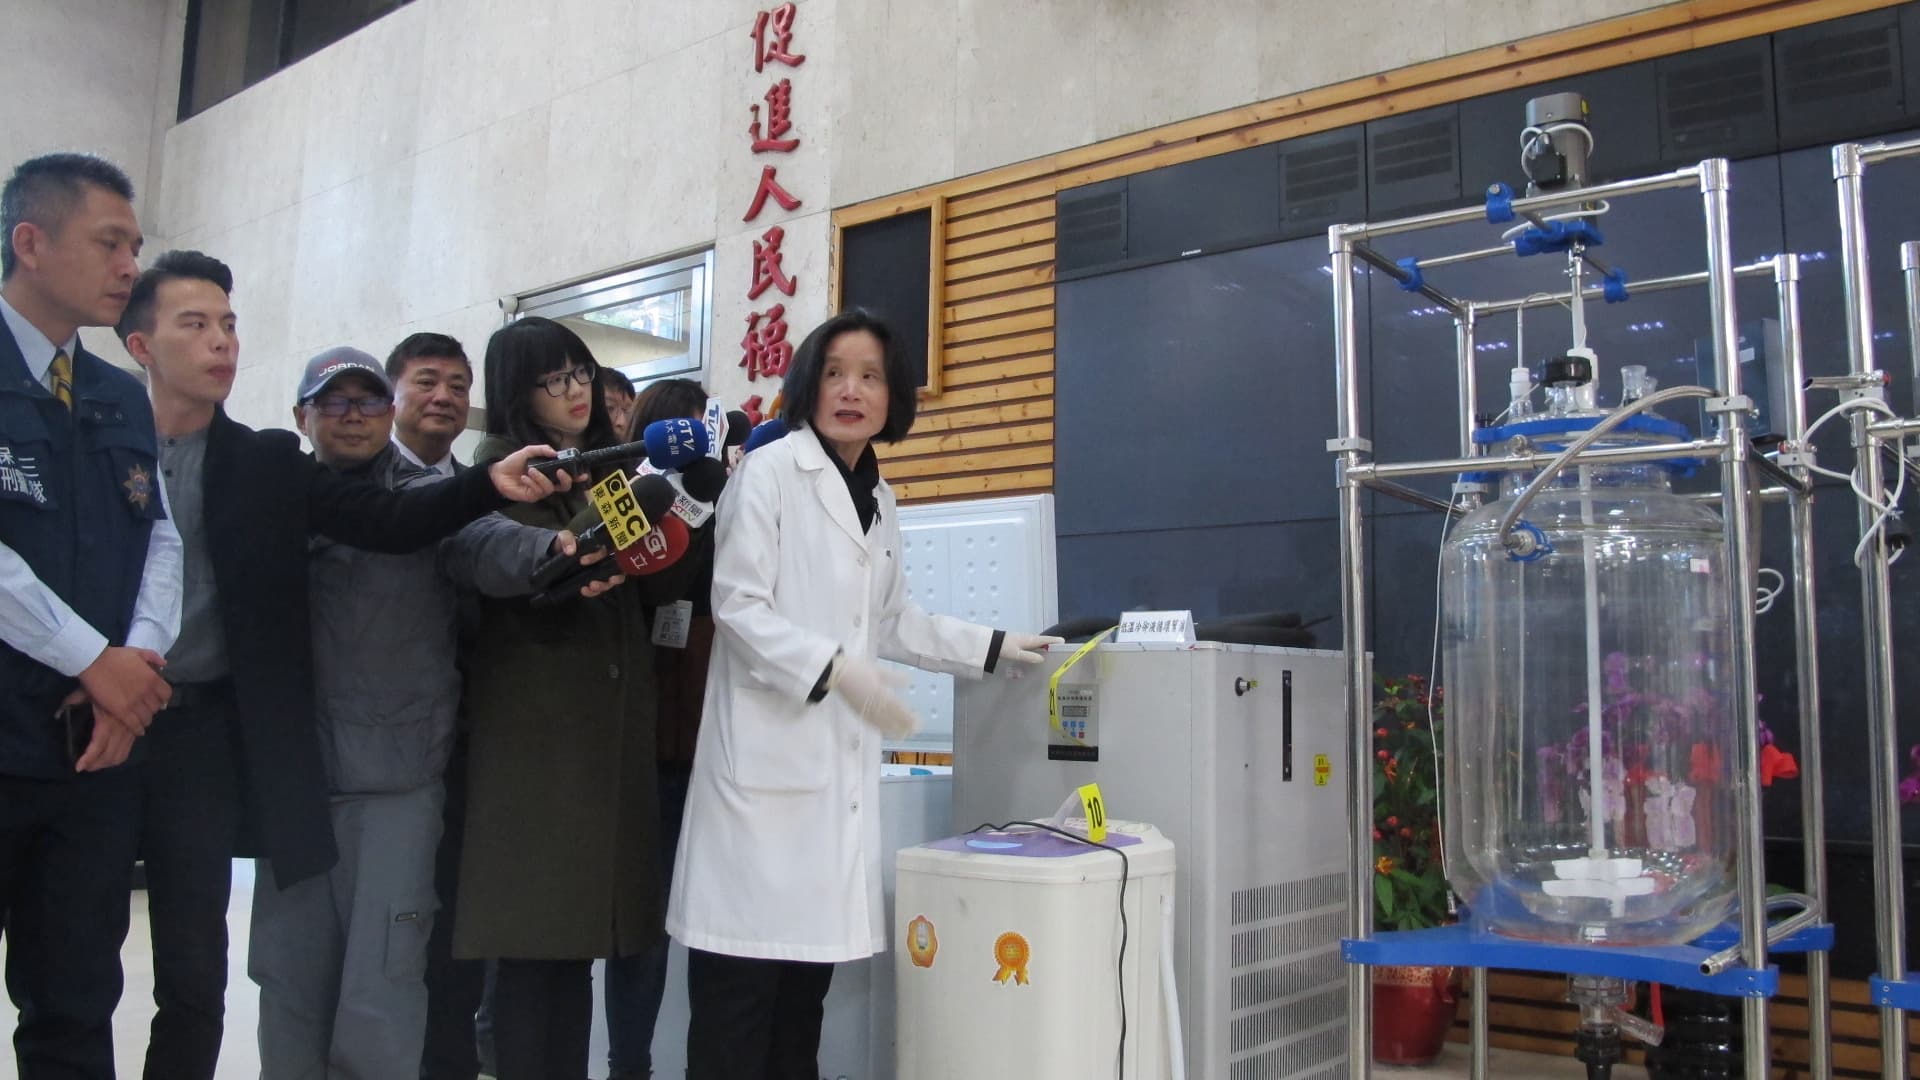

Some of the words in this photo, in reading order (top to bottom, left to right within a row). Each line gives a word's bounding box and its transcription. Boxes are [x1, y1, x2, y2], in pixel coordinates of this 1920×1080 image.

[319, 362, 375, 377] JORDAN
[678, 419, 696, 451] GTV
[707, 404, 720, 455] TVBS
[593, 487, 629, 546] 東森新聞
[676, 491, 704, 518] 新聞
[630, 551, 648, 570] 立
[1087, 796, 1103, 829] 10
